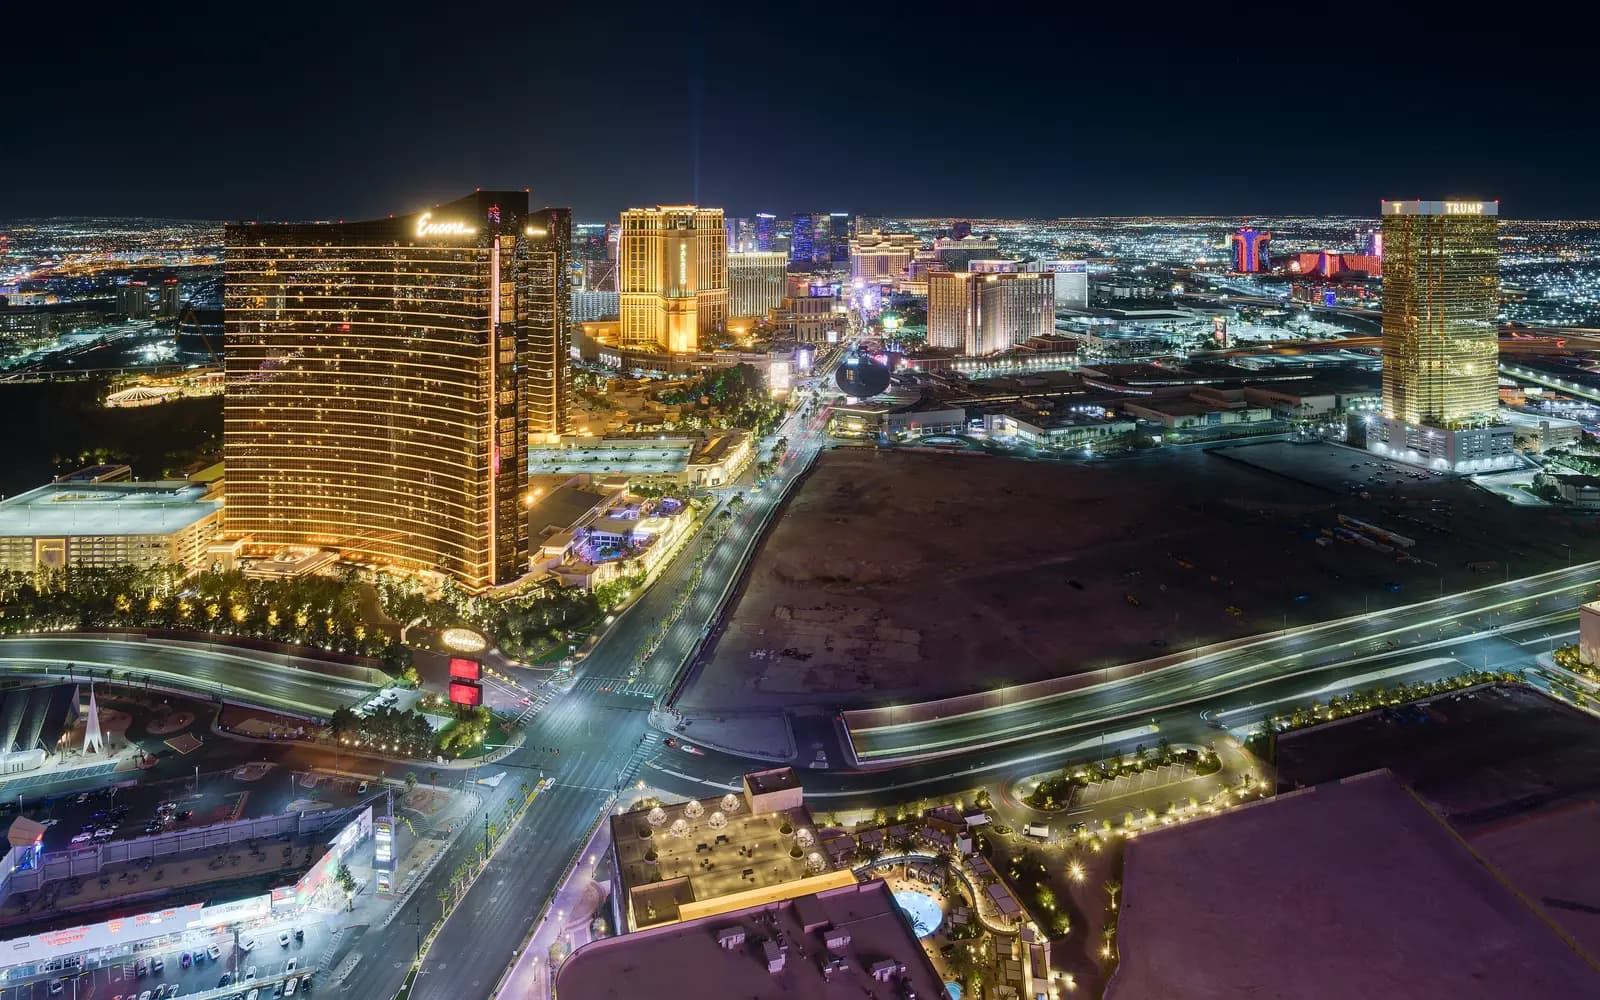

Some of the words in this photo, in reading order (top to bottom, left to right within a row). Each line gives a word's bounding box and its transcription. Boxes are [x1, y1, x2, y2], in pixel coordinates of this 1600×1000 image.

[1392, 203, 1402, 214] T
[1446, 203, 1482, 214] TRUMP
[416, 212, 476, 237] Encore
